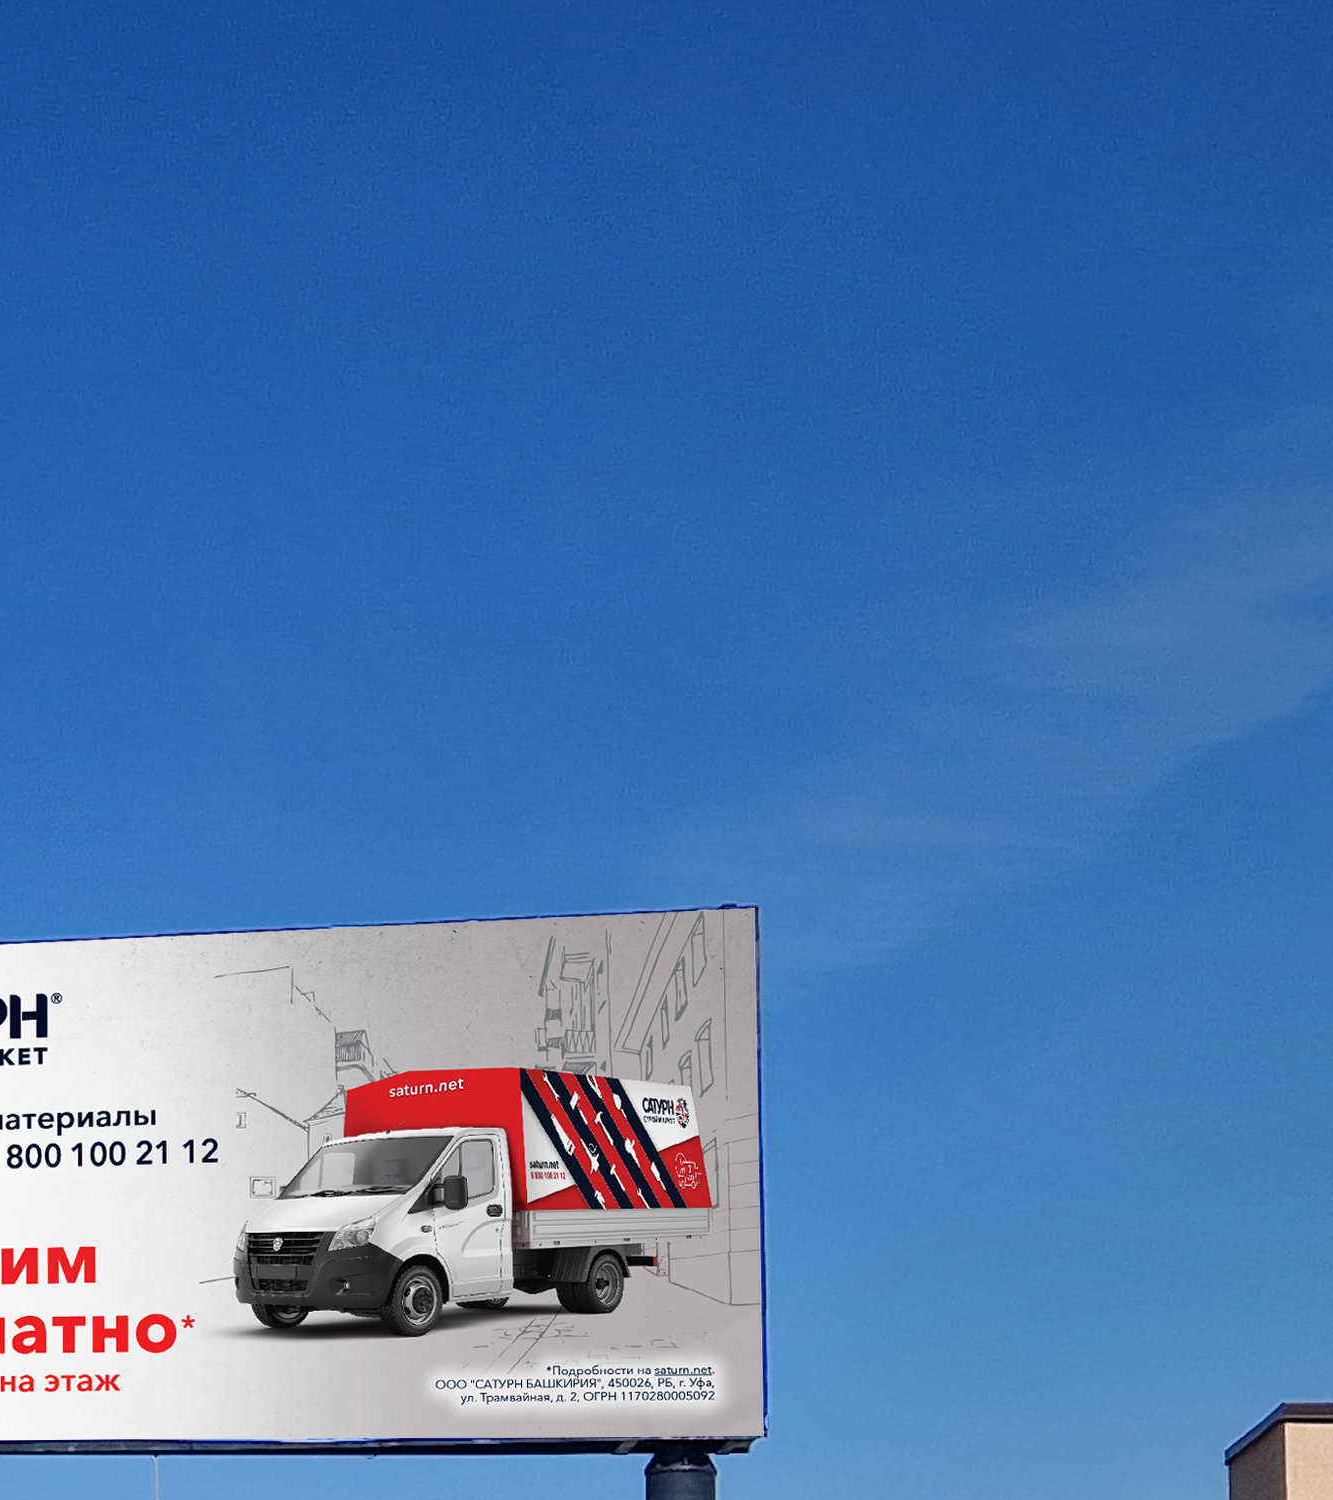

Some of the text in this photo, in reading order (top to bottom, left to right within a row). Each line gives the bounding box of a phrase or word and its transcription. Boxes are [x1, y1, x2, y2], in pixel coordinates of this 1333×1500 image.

[389, 1077, 465, 1098] saturn.net
[642, 1097, 675, 1115] САТУРН
[7, 1144, 62, 1169] 800
[72, 1142, 126, 1167] 100
[136, 1140, 167, 1166] 21
[183, 1139, 219, 1164] 12
[0, 1375, 35, 1393] на
[44, 1372, 121, 1393] этаж
[435, 1379, 468, 1390] ООО
[470, 1379, 523, 1390] "САТУРН
[607, 1377, 654, 1390] 450026,
[689, 1377, 715, 1390] Уфа,
[460, 1395, 478, 1405] ул.
[480, 1393, 554, 1405] Трамвайная,
[583, 1391, 618, 1402] ОГРН
